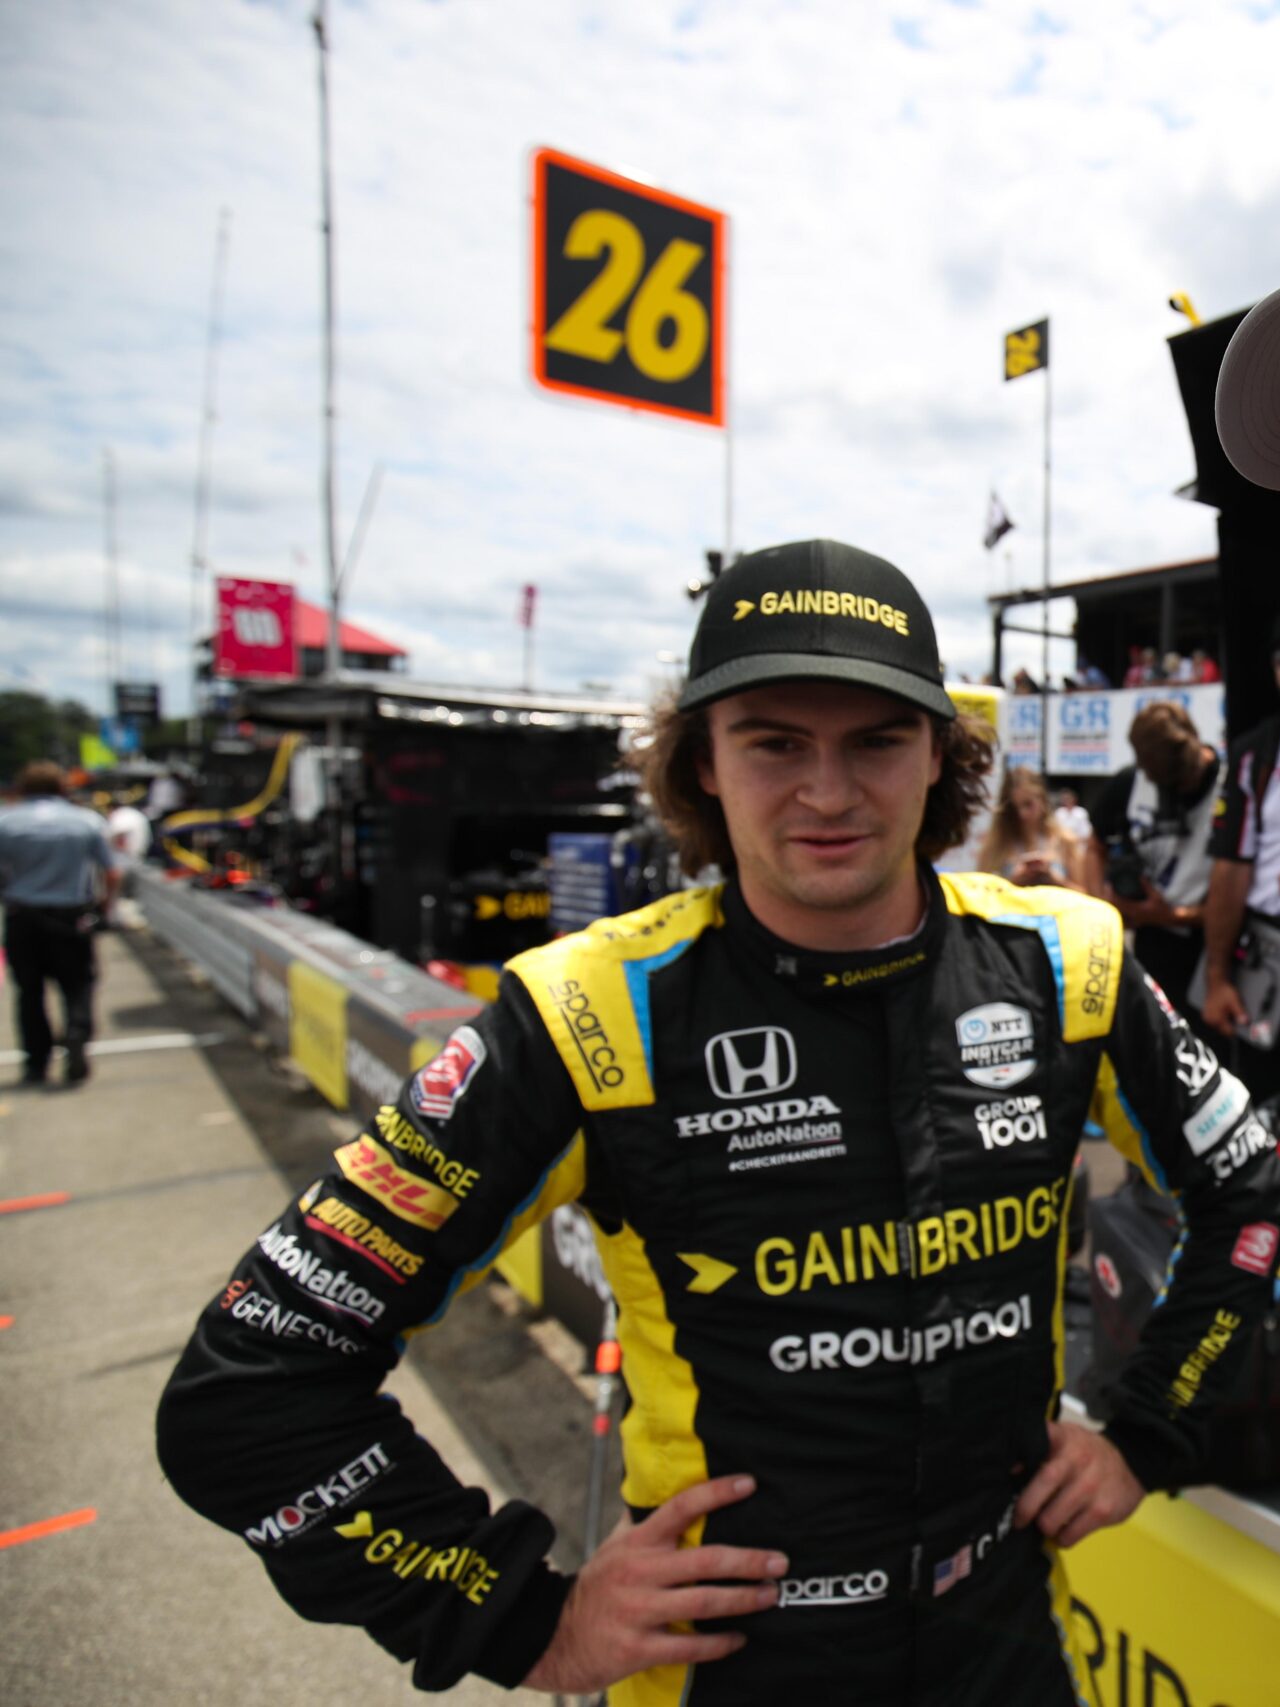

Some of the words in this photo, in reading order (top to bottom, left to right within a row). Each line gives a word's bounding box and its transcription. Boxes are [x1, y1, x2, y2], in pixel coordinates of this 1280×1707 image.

[543, 208, 710, 383] 26
[759, 589, 911, 637] GAINBRIDGE
[1060, 699, 1111, 730] GR
[549, 979, 625, 1093] sparco
[991, 1018, 1023, 1034] NTT
[961, 1038, 1035, 1063] INDYCAR
[674, 1094, 842, 1138] HONDA
[974, 1095, 1042, 1121] GROUP
[977, 1109, 1048, 1150] 1001
[727, 1120, 843, 1153] AutoNation
[354, 1143, 430, 1214] DHL
[312, 1197, 370, 1238] AUTO
[358, 1226, 424, 1276] PARTS
[257, 1222, 386, 1318] AutoNation
[768, 1294, 1033, 1373] GROUP1001
[244, 1442, 392, 1543] MOCKETT
[779, 1569, 888, 1608] parco
